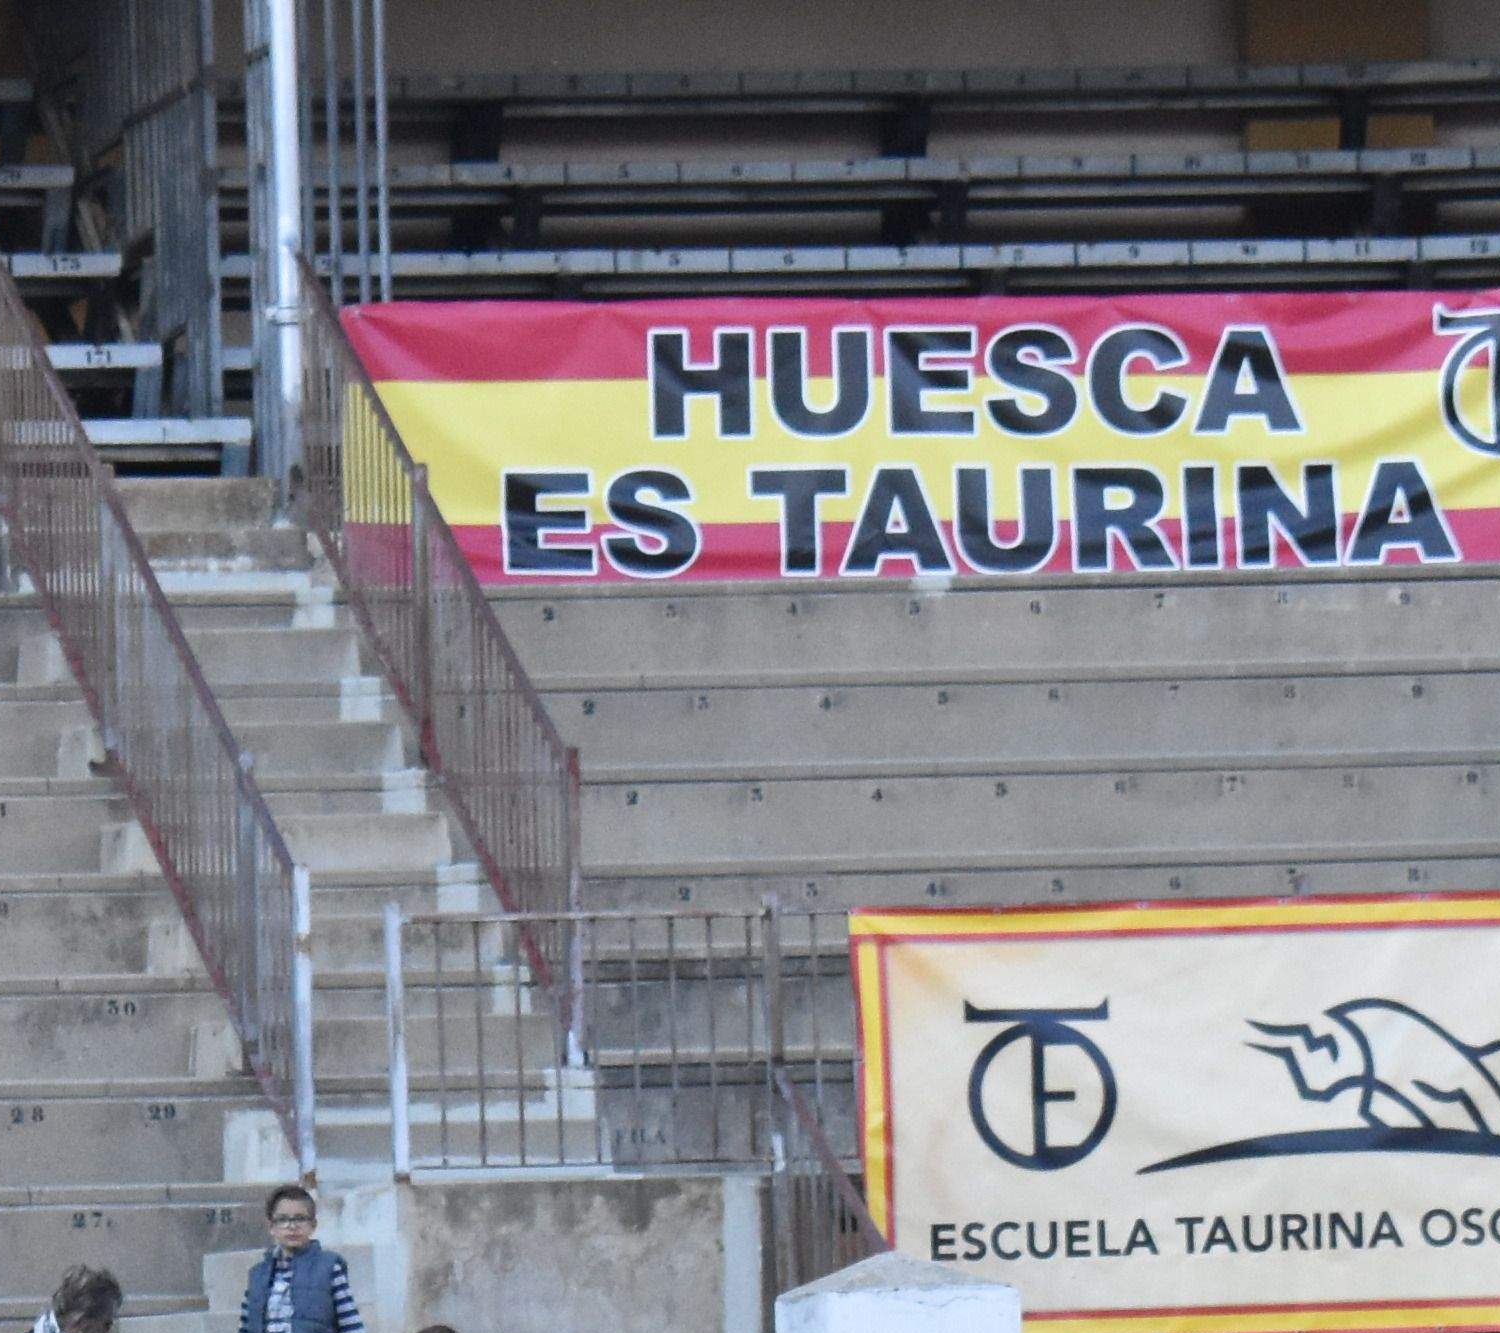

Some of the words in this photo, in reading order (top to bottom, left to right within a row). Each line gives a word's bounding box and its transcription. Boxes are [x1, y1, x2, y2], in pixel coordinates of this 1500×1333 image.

[647, 326, 1308, 440] HUESCA
[503, 468, 700, 578] ES
[750, 458, 1458, 577] TAURINA
[930, 1219, 1158, 1262] ESCUELA
[1177, 1211, 1401, 1255] TAURINA
